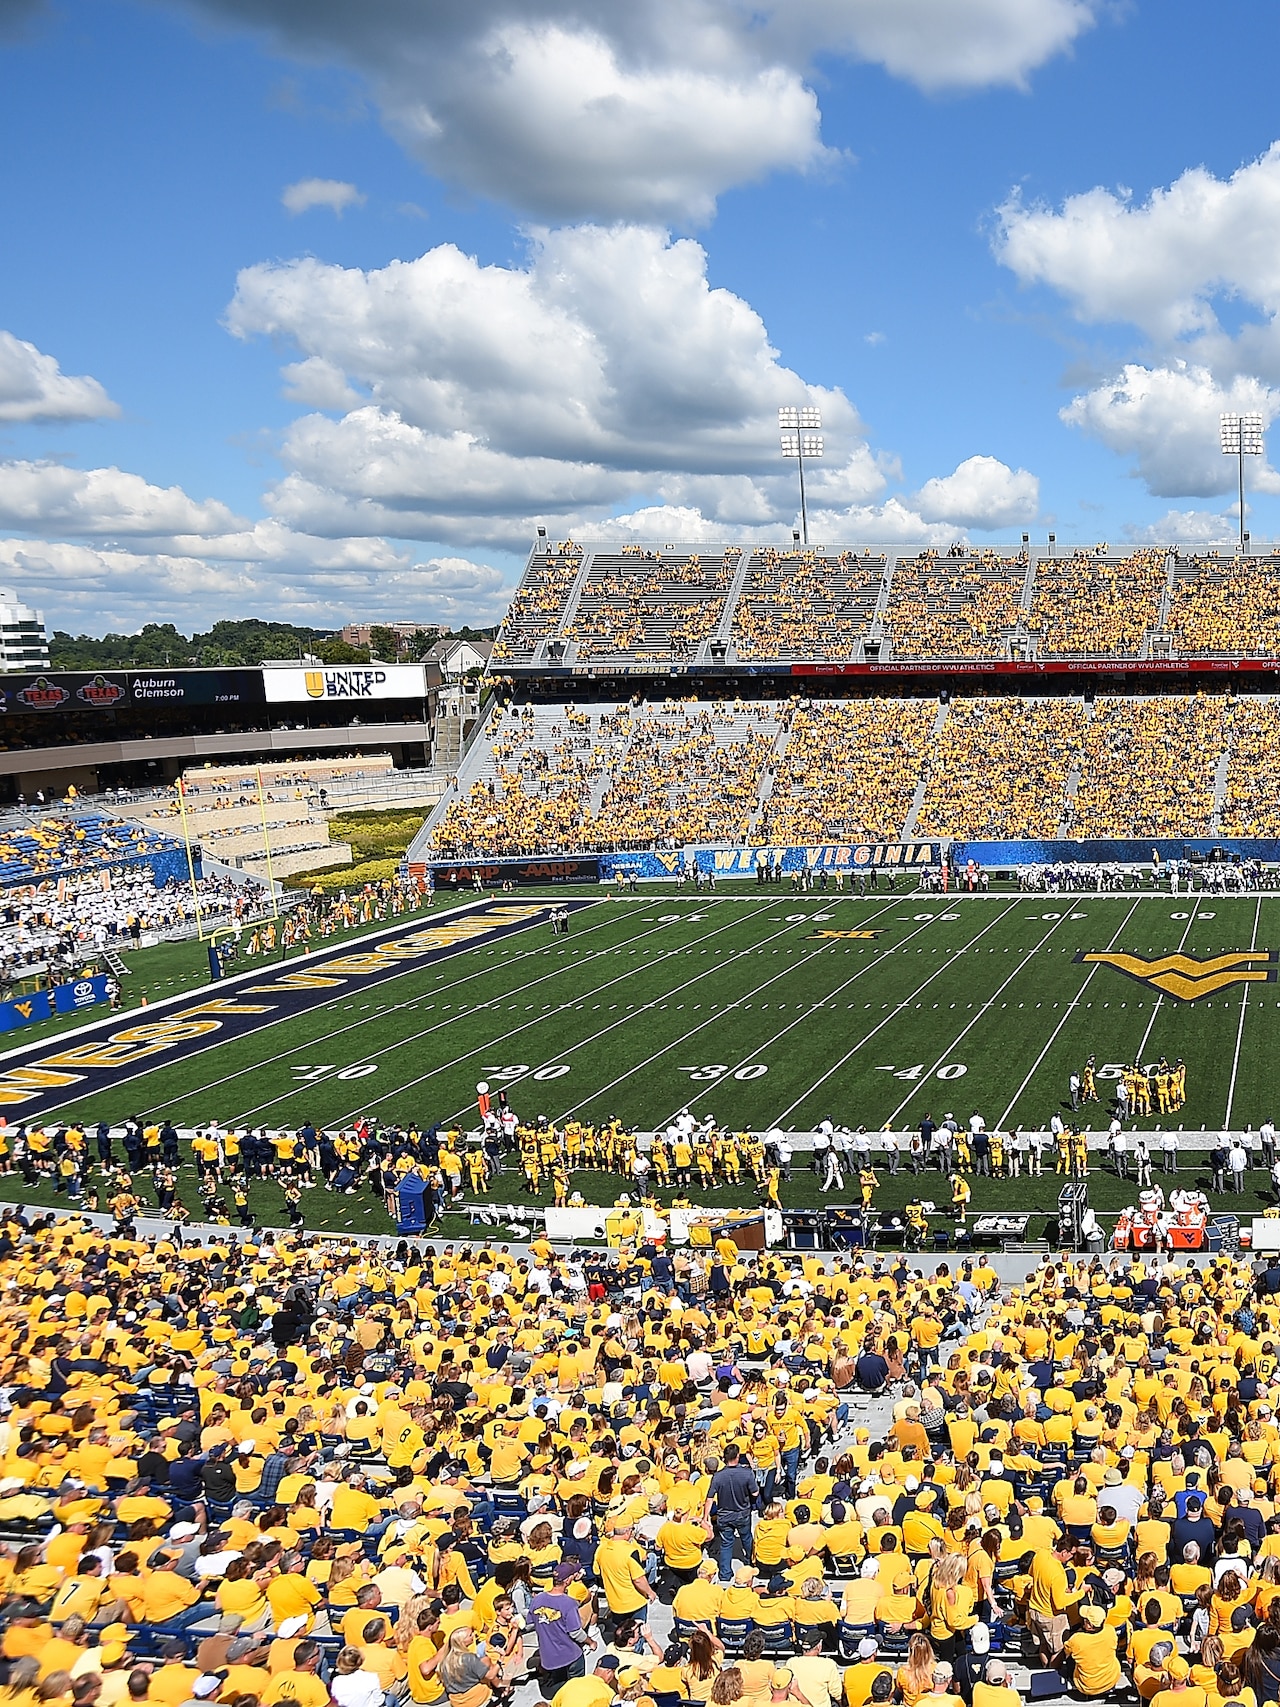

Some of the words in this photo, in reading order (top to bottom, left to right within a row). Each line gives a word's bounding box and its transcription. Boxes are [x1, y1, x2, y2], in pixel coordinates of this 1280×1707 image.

[133, 679, 176, 689] Auburn
[325, 672, 387, 684] UNITED
[25, 690, 63, 702] TEXAS
[84, 687, 119, 699] TEXAS
[134, 688, 184, 699] Clemson
[327, 683, 373, 696] BANK
[715, 850, 787, 869] WEST
[806, 845, 932, 868] VIRGINIA
[518, 863, 581, 877] AARP
[611, 861, 643, 869] NISSAN
[439, 866, 501, 879] AARP
[236, 902, 570, 994] VIRGINIA
[73, 994, 97, 1004] TOYOTA
[296, 1063, 379, 1080] 10
[488, 1064, 572, 1080] 20
[688, 1063, 769, 1080] 30
[892, 1063, 968, 1080] 40
[523, 1156, 535, 1165] 25
[907, 1209, 920, 1218] 32
[1188, 1288, 1194, 1298] 9
[1259, 1360, 1270, 1373] 16
[400, 1428, 412, 1443] 8
[493, 1423, 503, 1439] 8
[455, 1448, 467, 1461] 17
[60, 1582, 80, 1605] 7
